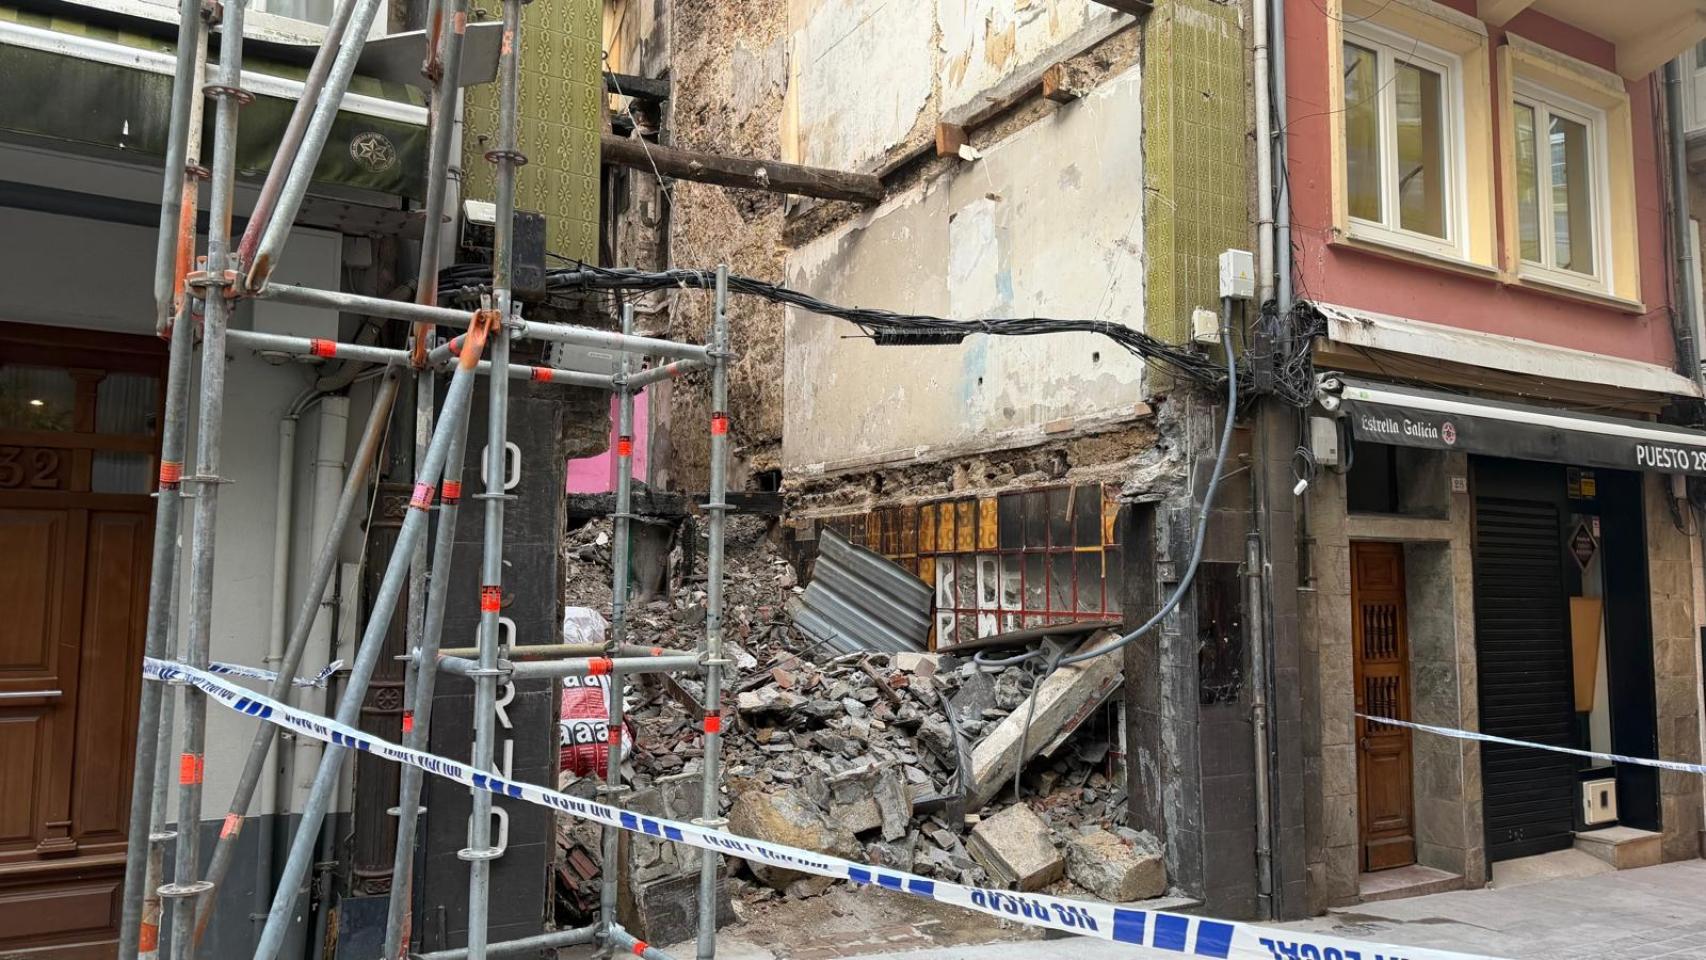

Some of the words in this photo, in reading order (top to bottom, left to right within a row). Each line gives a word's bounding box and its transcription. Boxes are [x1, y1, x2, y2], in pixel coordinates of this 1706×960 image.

[1362, 415, 1399, 433] Estrella
[1404, 419, 1438, 438] Galicia
[0, 447, 58, 487] 32
[1636, 445, 1689, 469] PUESTO
[1691, 451, 1706, 470] 28
[971, 892, 1050, 923] PASAR
[1051, 903, 1098, 931] NO
[1260, 938, 1362, 960] CAL
